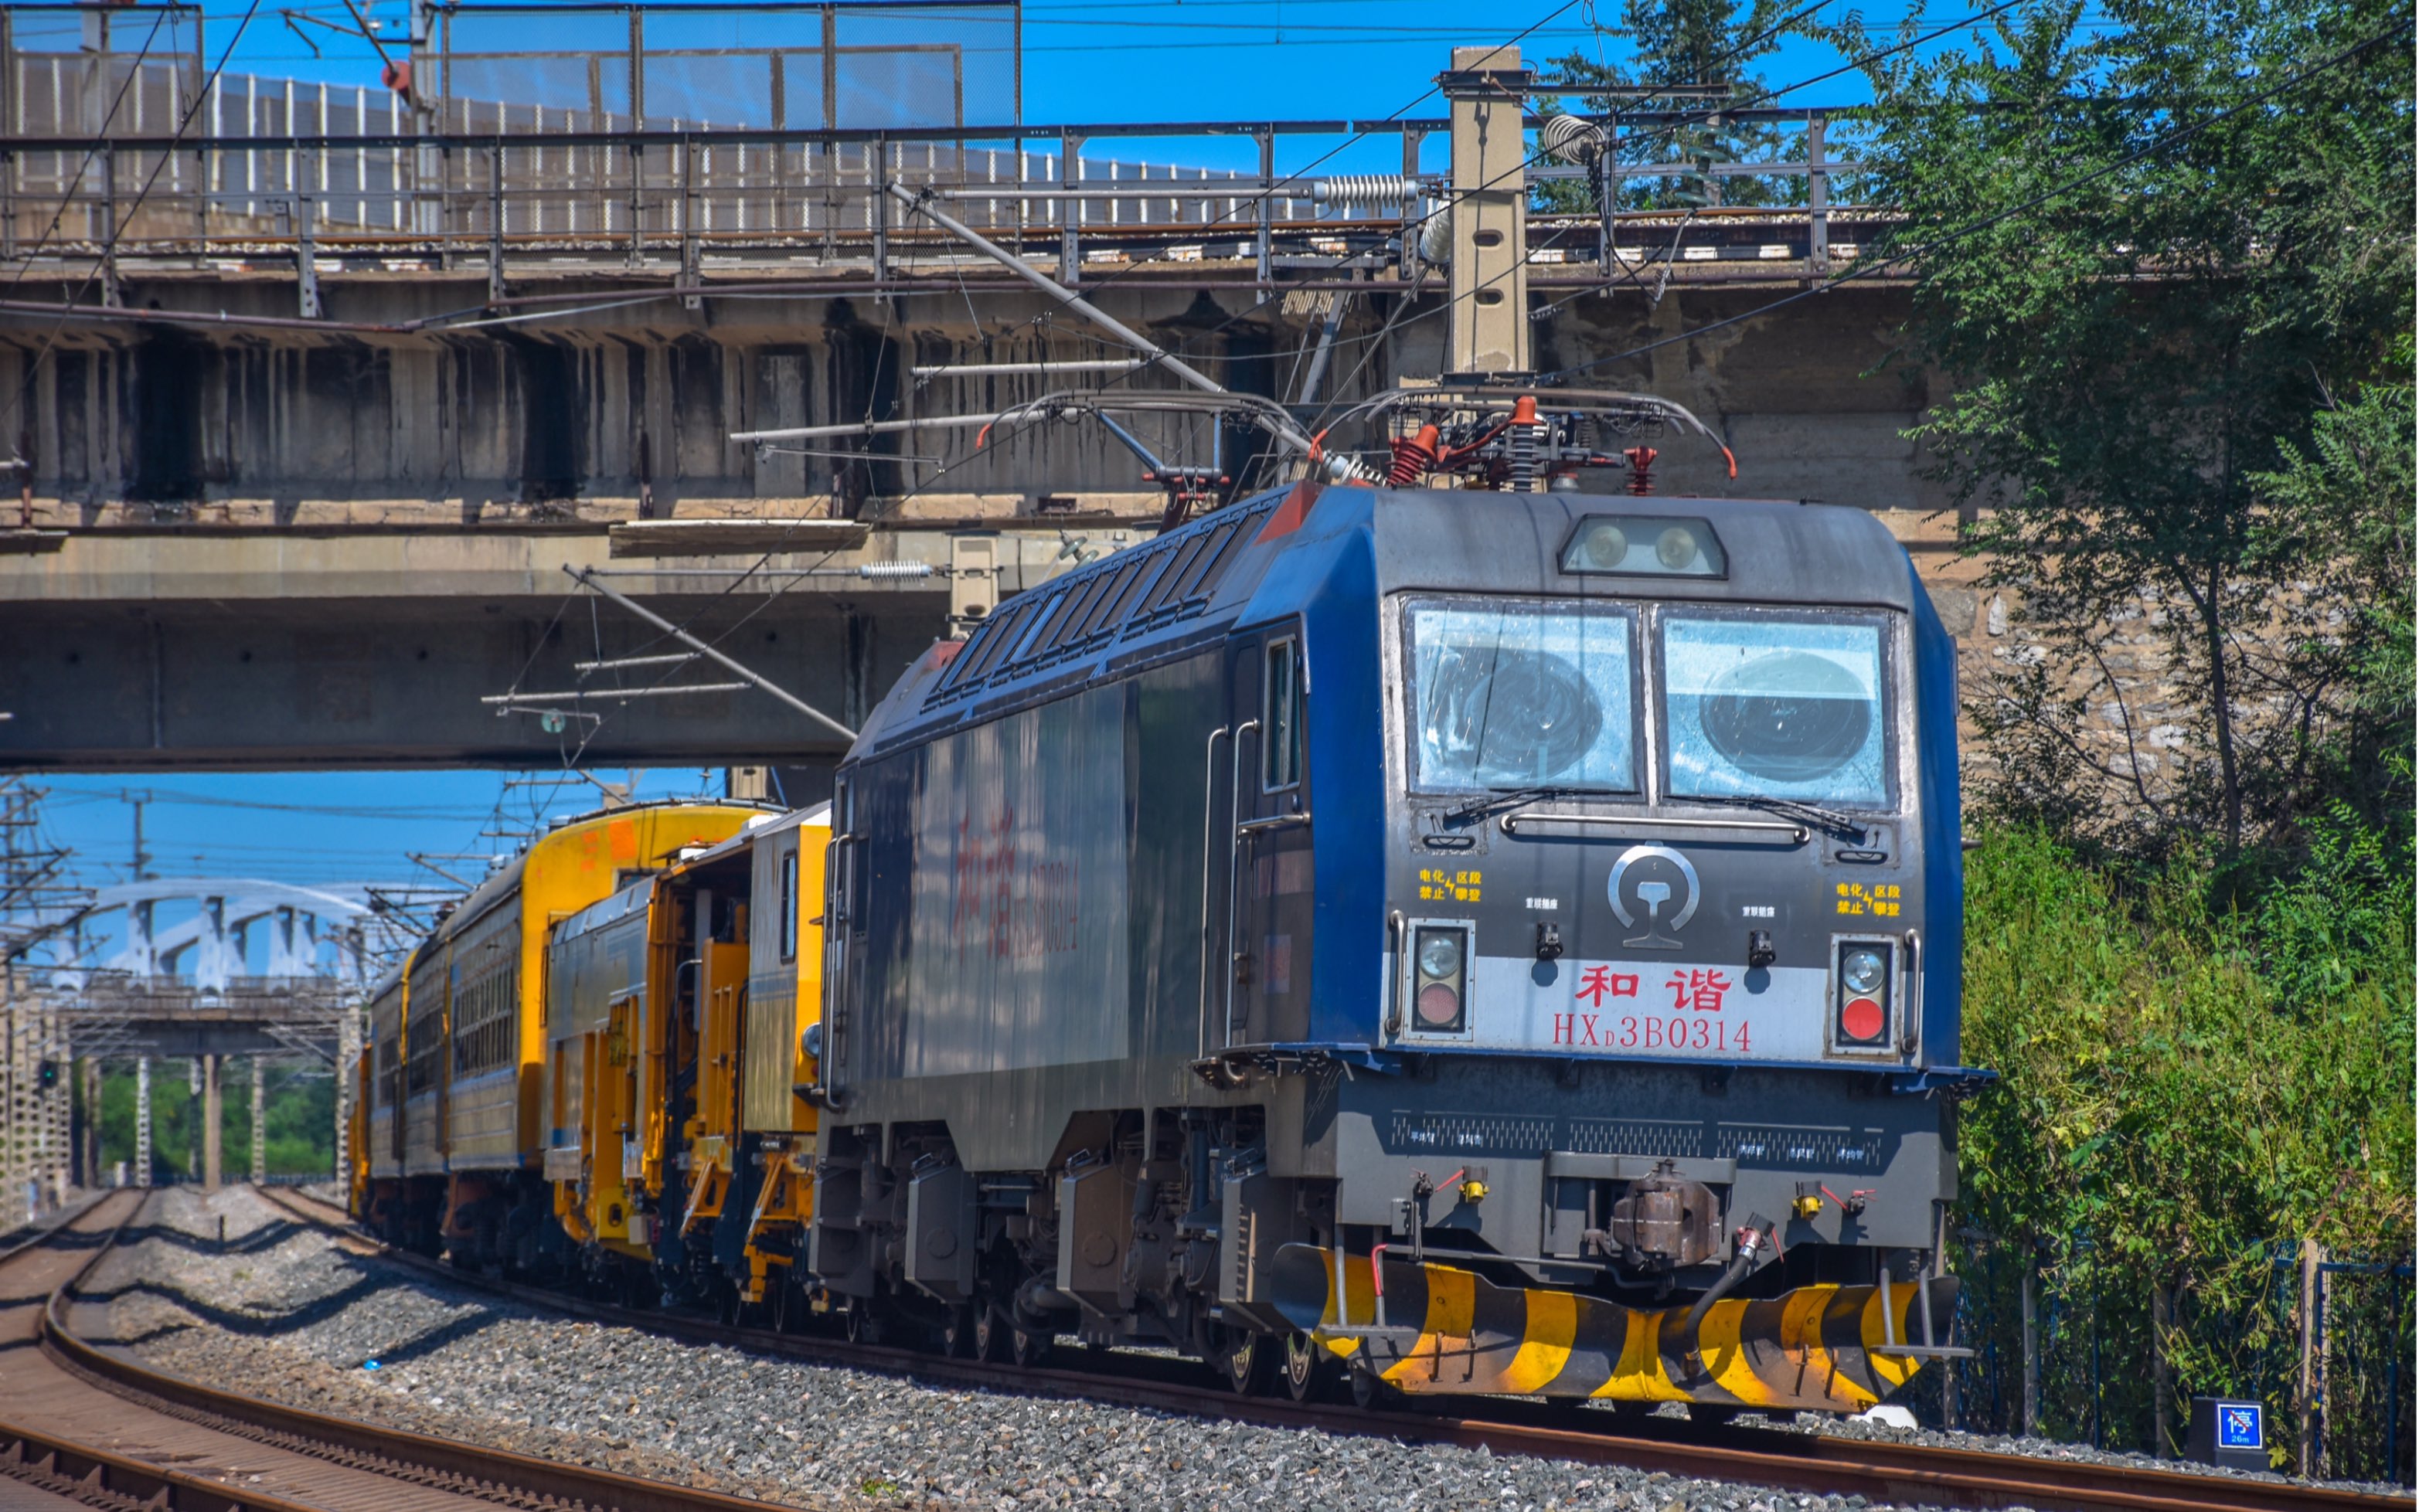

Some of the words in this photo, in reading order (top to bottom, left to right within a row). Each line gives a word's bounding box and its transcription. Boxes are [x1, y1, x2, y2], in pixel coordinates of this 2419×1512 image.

[1574, 965, 1732, 1012] 和谐
[1553, 1013, 1751, 1052] HXD3B0314
[2227, 1410, 2253, 1433] 停
[2231, 1435, 2250, 1443] 26m
